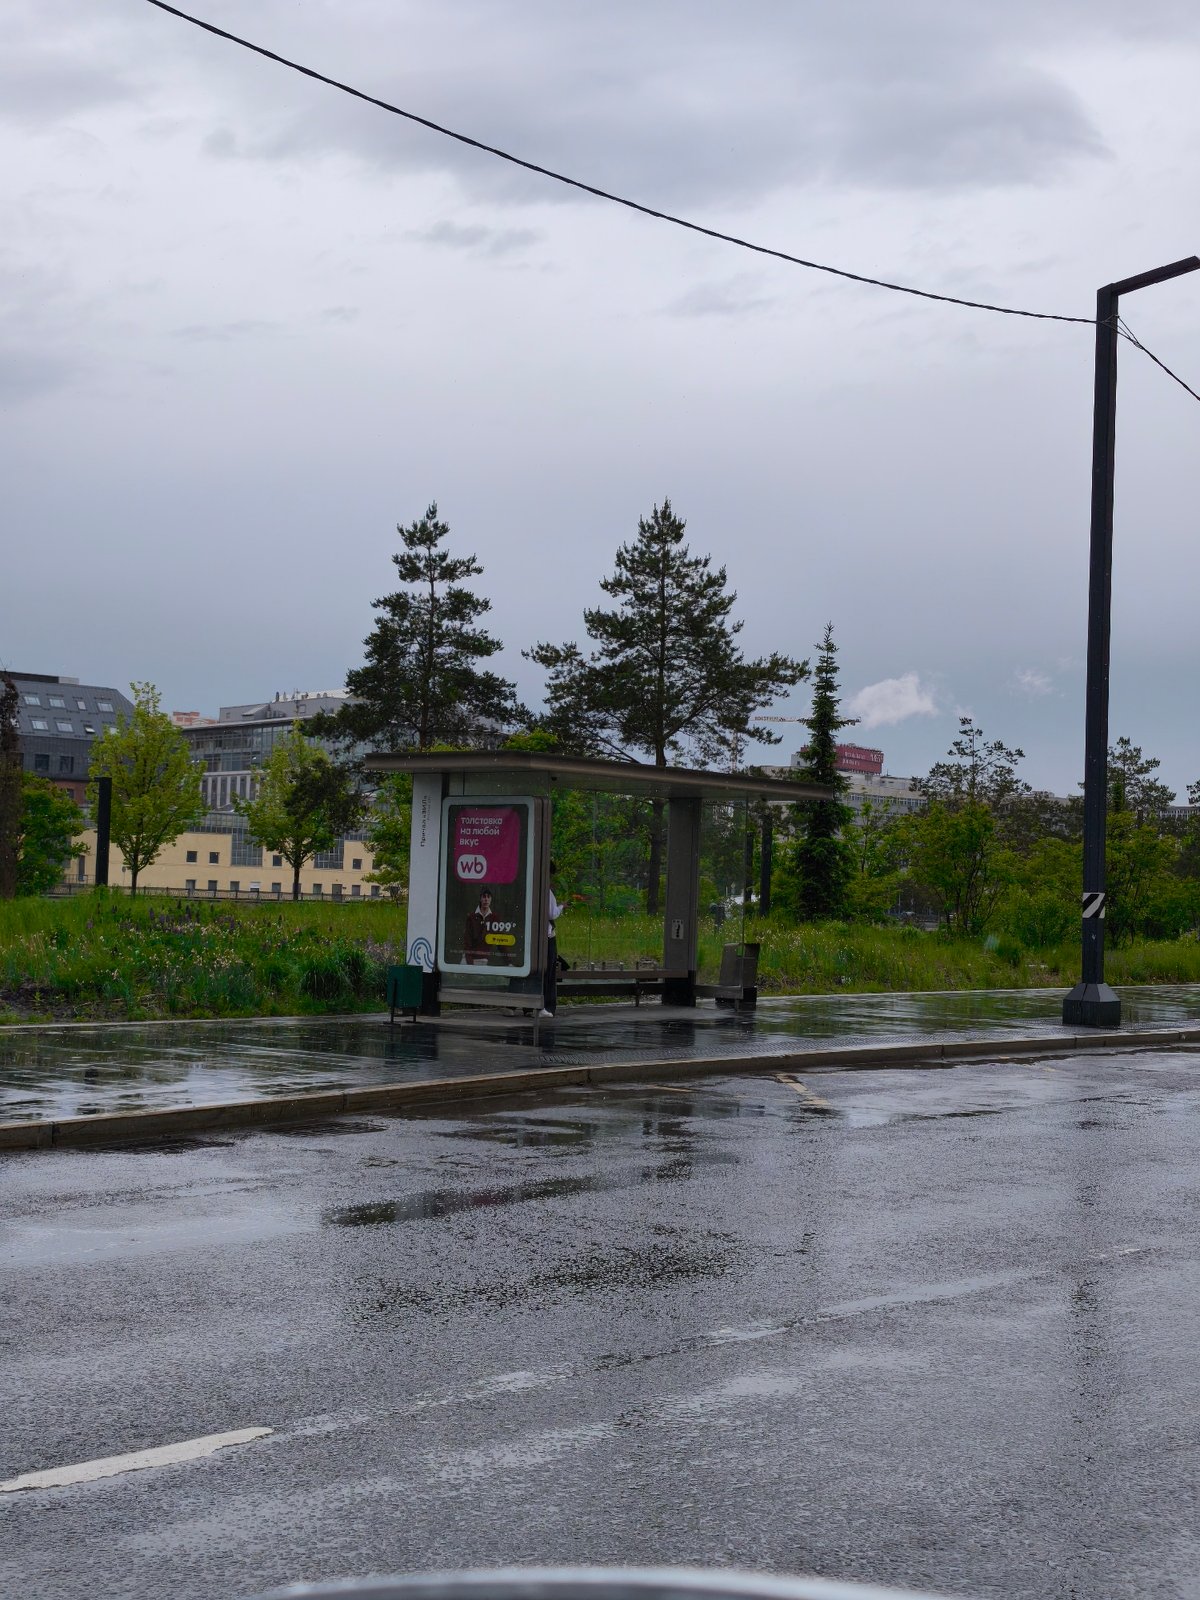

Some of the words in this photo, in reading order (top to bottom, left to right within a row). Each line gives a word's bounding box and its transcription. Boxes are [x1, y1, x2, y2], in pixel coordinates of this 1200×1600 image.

[461, 817, 503, 825] толстовка
[472, 826, 500, 836] любой
[459, 838, 479, 847] вкус
[460, 857, 484, 874] wb
